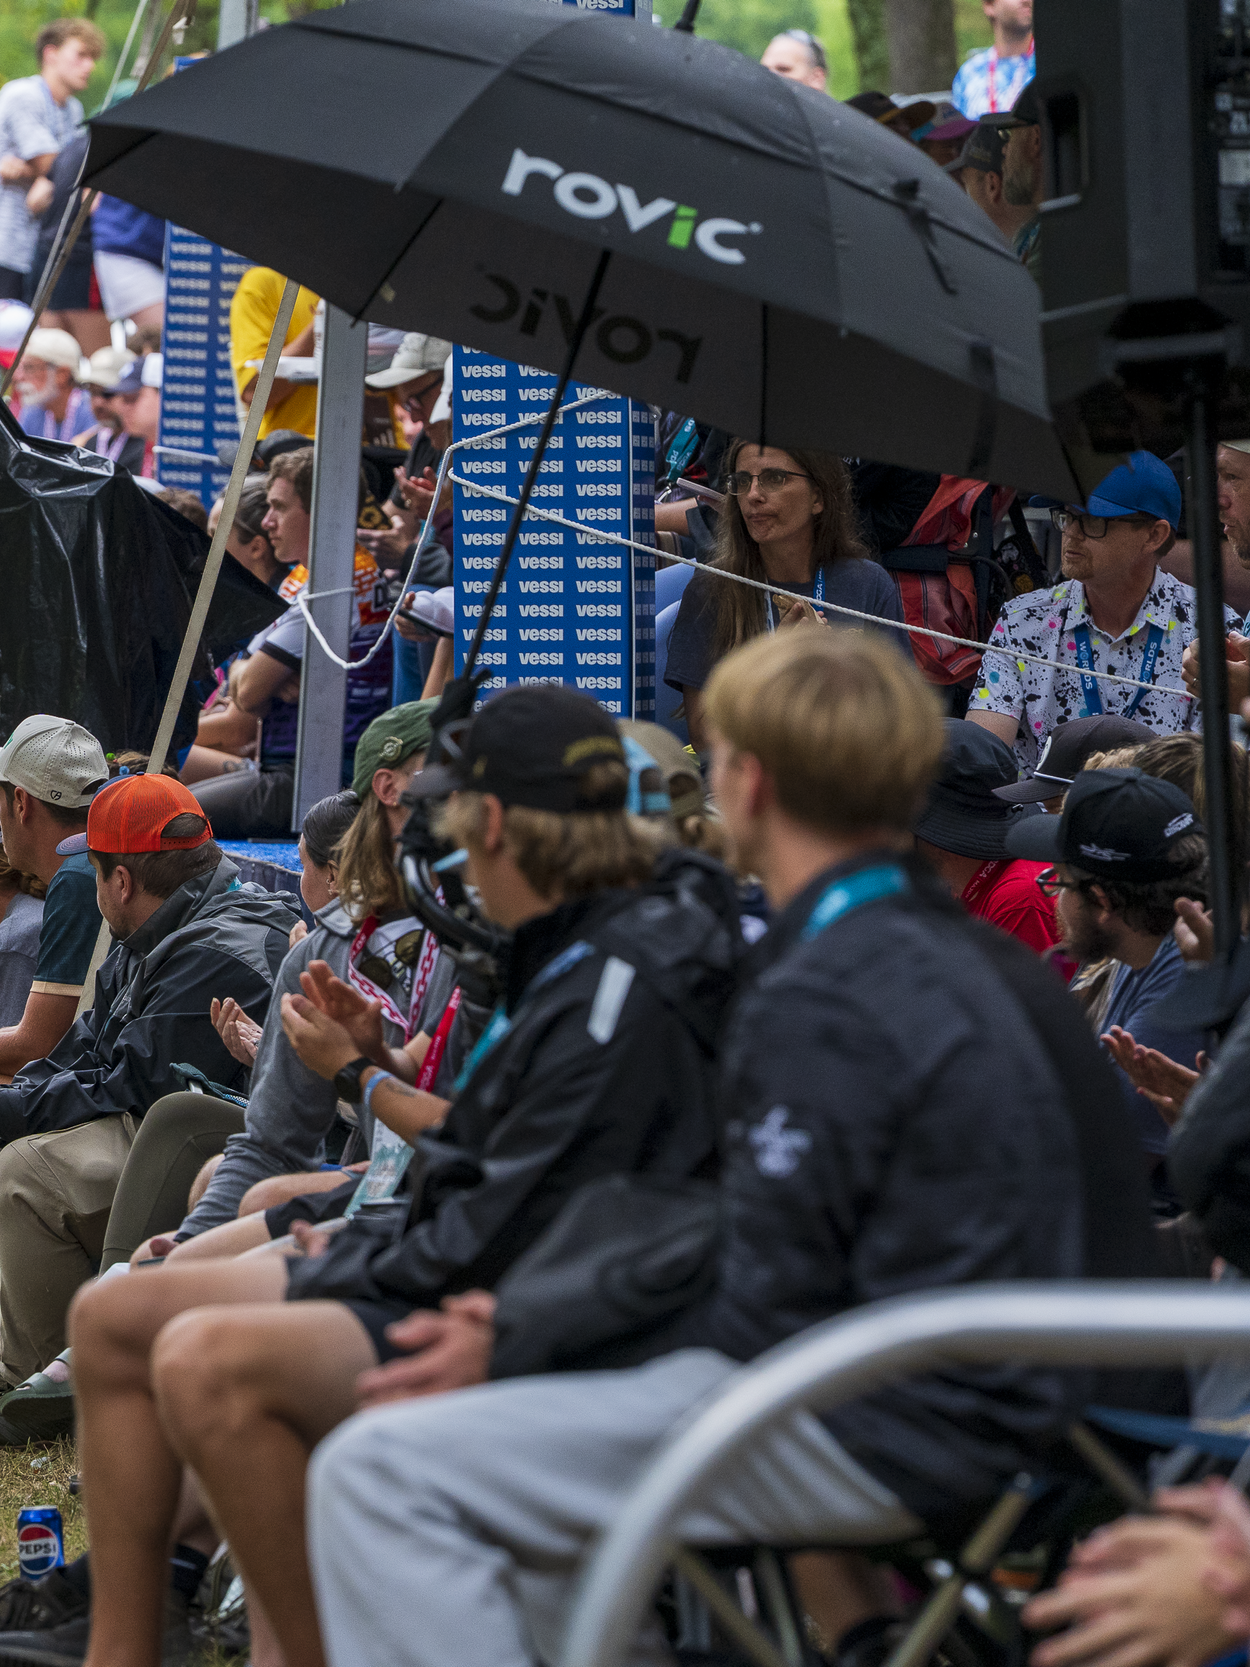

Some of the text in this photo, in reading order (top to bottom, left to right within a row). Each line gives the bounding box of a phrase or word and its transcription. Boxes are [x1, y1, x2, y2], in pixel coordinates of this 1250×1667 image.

[502, 147, 746, 265] rovic
[461, 364, 506, 378] vessi
[461, 388, 506, 402] vessi
[518, 388, 558, 400] vess
[461, 412, 506, 426] vessi
[576, 411, 622, 424] vessi
[576, 435, 622, 448] vessi
[461, 459, 622, 474] vessi vssi vessi
[576, 483, 622, 496] vessi
[461, 508, 506, 522] vessi
[576, 508, 622, 520] vessi
[462, 532, 507, 546] vessi
[518, 532, 564, 545] vessi
[462, 556, 622, 570] vess vessi vessi
[518, 580, 564, 593] vessi
[576, 580, 622, 592] vessi
[518, 604, 564, 617] vessi
[576, 604, 622, 617] vessi
[518, 628, 564, 641] vessi
[576, 628, 622, 641] vessi
[518, 652, 564, 665] vessi
[576, 652, 622, 665] vessi
[576, 676, 622, 689] vessi
[19, 1542, 56, 1555] PEPSI
